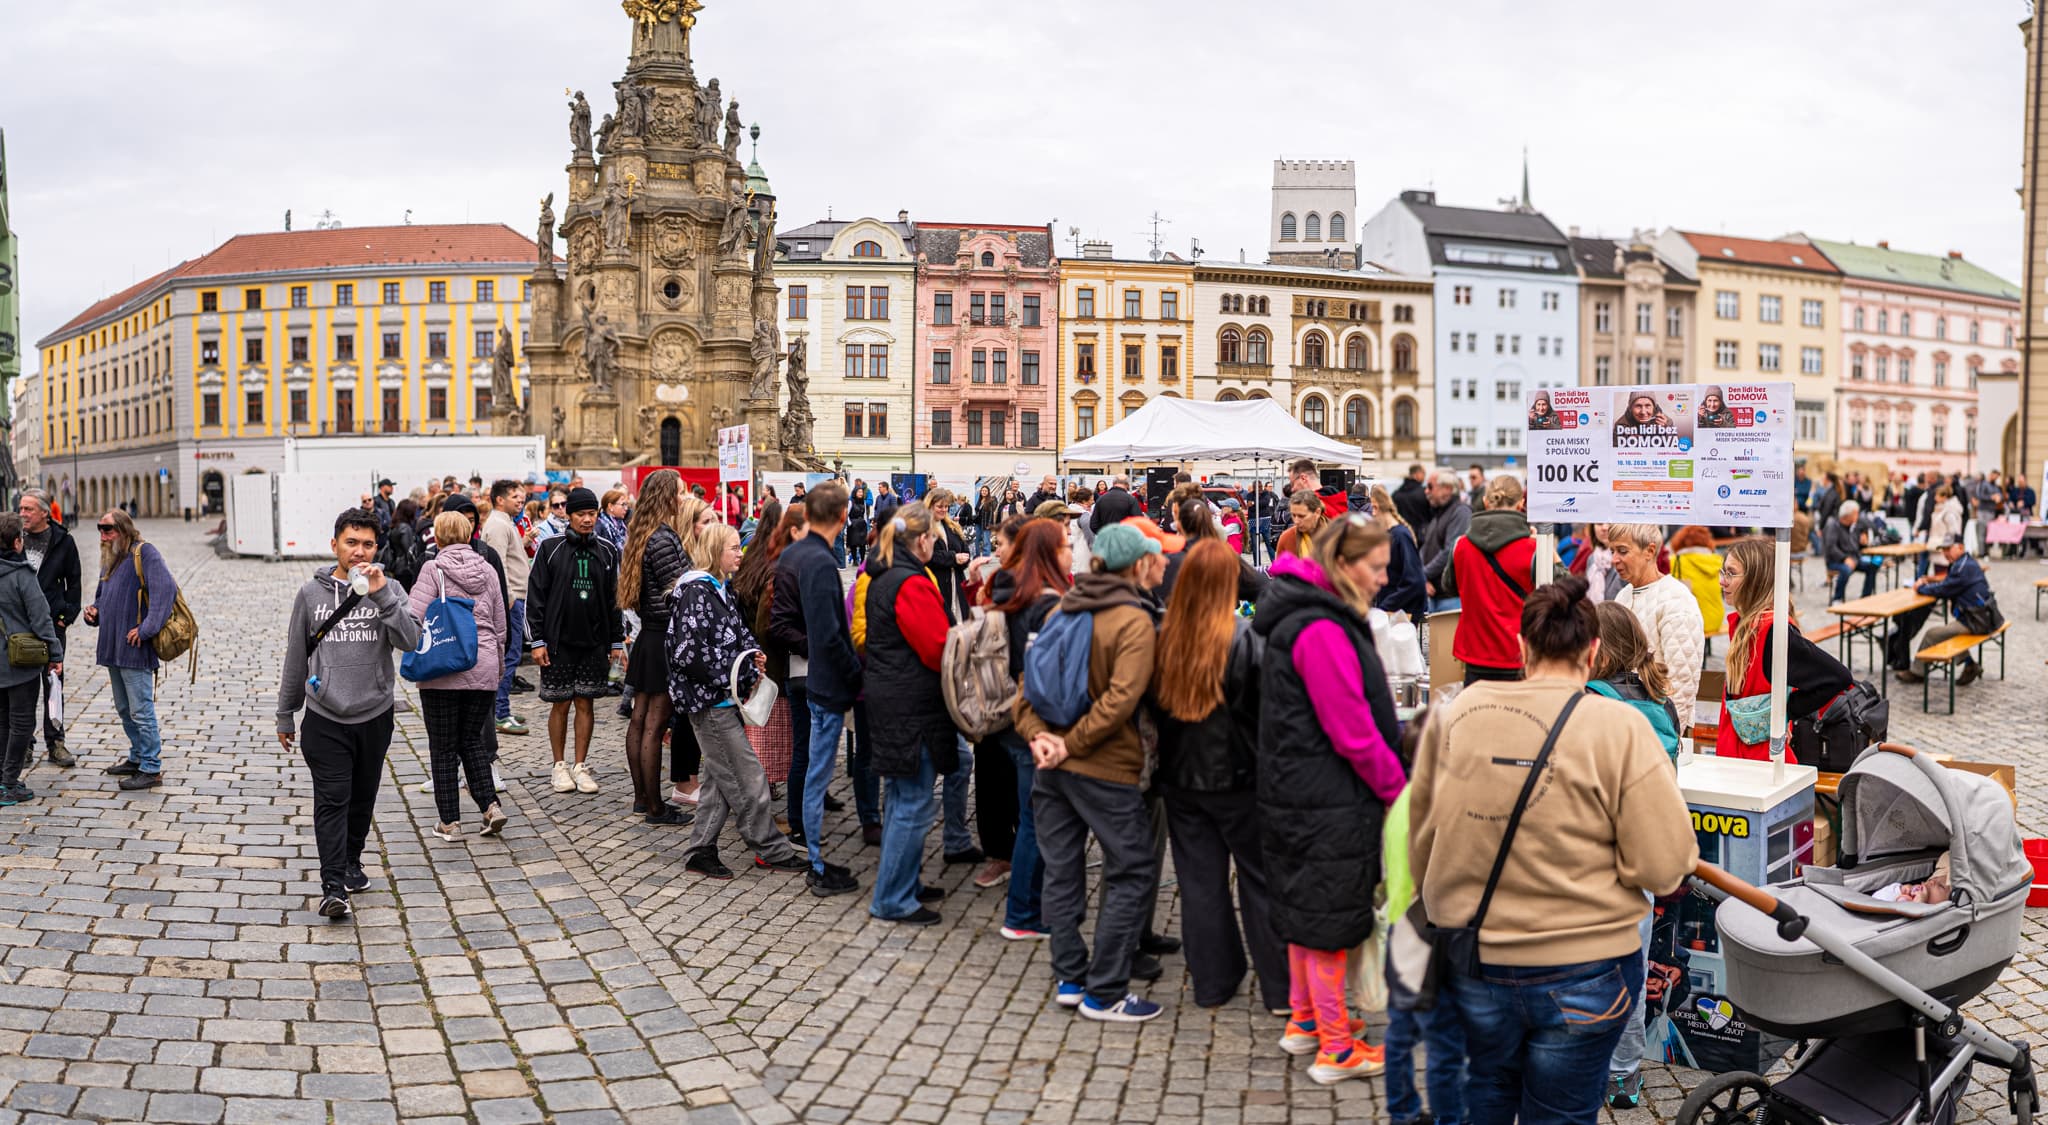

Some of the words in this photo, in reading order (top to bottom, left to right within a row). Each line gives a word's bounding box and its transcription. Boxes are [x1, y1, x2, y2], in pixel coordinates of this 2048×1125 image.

[1616, 425, 1638, 434] Den
[1658, 424, 1678, 434] bez
[1617, 436, 1679, 448] DOMOVA
[1551, 447, 1590, 455] POLÉVKOU
[1537, 464, 1568, 482] 100
[1573, 460, 1599, 482] KČ
[577, 559, 588, 577] 11
[314, 604, 380, 621] Hoister
[324, 630, 378, 642] CALIFORNIA
[1731, 1020, 1746, 1029] PRO
